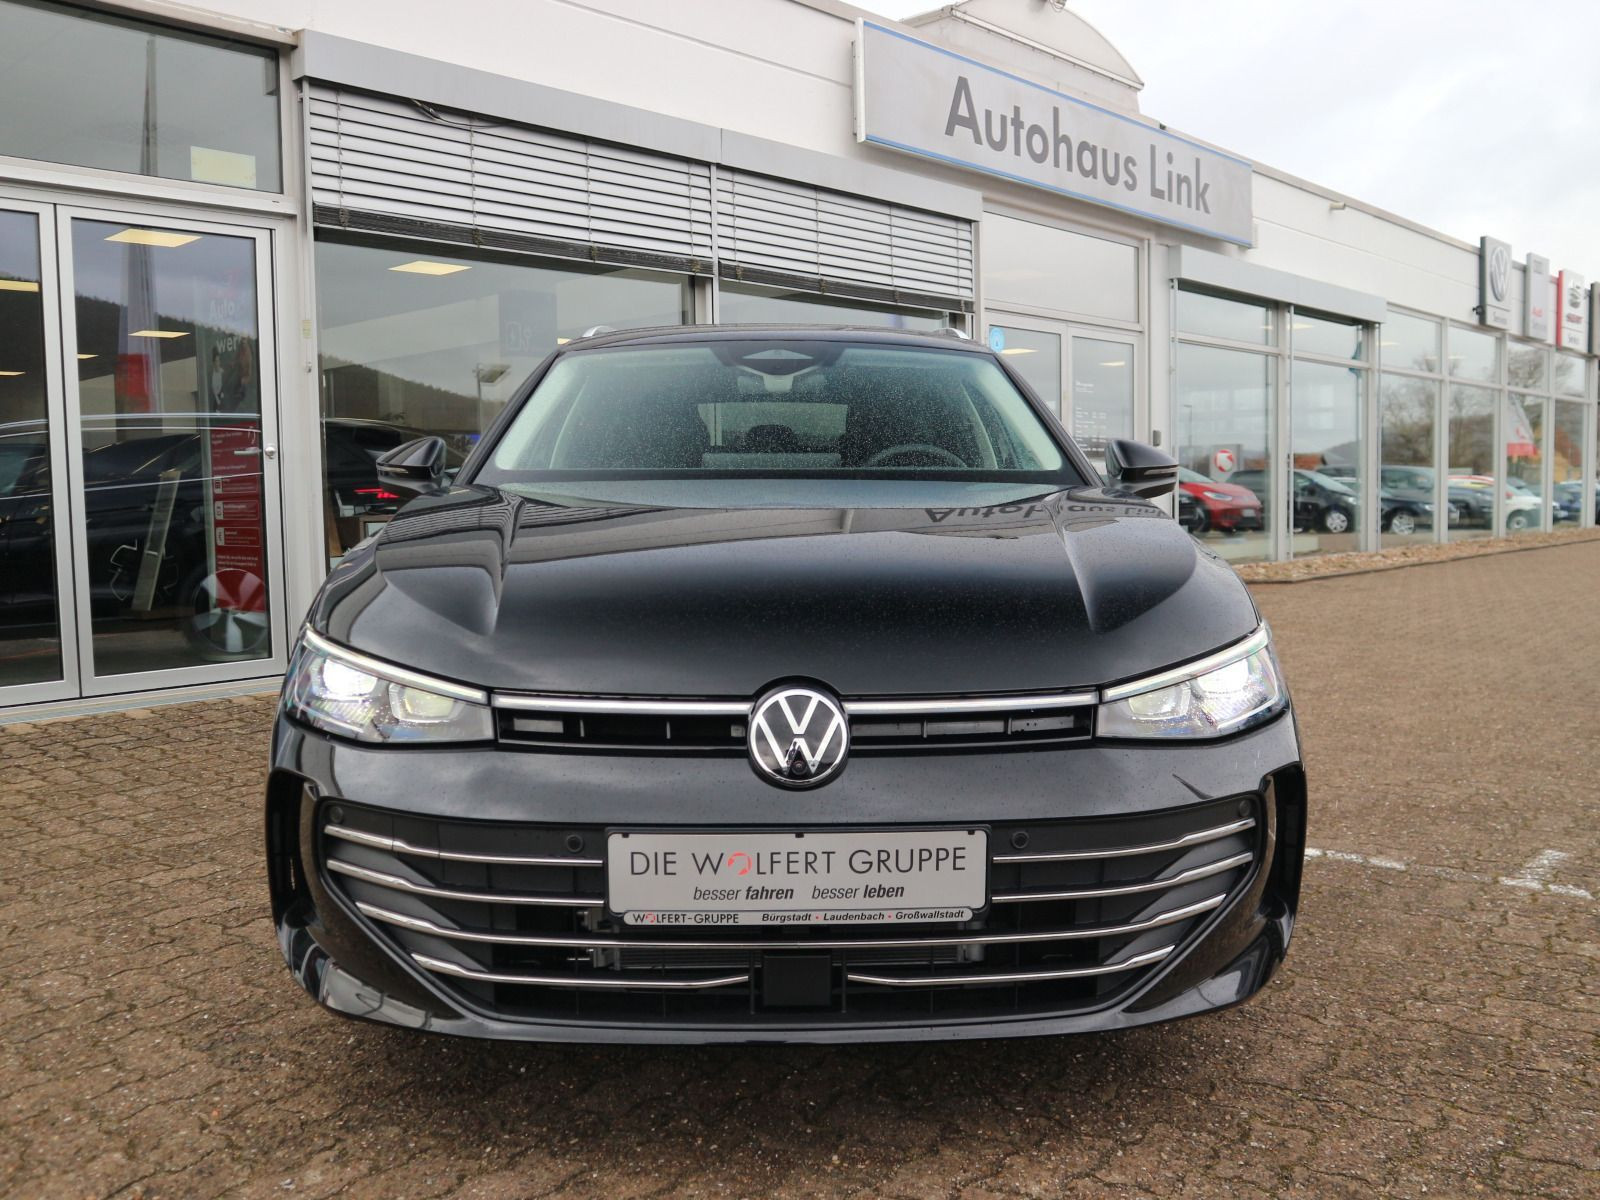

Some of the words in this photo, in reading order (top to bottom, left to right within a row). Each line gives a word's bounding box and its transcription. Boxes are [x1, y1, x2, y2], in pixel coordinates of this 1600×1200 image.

[944, 75, 1138, 193] Autohaus
[1149, 143, 1211, 215] Link
[751, 689, 847, 782] VW
[630, 851, 677, 876] DIE
[692, 850, 836, 876] WOLFERT
[848, 847, 966, 874] GRUPPE
[693, 886, 742, 901] besser
[745, 886, 794, 901] fahren
[811, 885, 860, 900] besser
[863, 884, 905, 899] leben
[633, 912, 740, 924] WOLFERT-GRUPPE
[761, 912, 812, 923] Bürgstadt
[823, 911, 885, 922] Laudenbach
[895, 909, 965, 921] Großwallstadt
